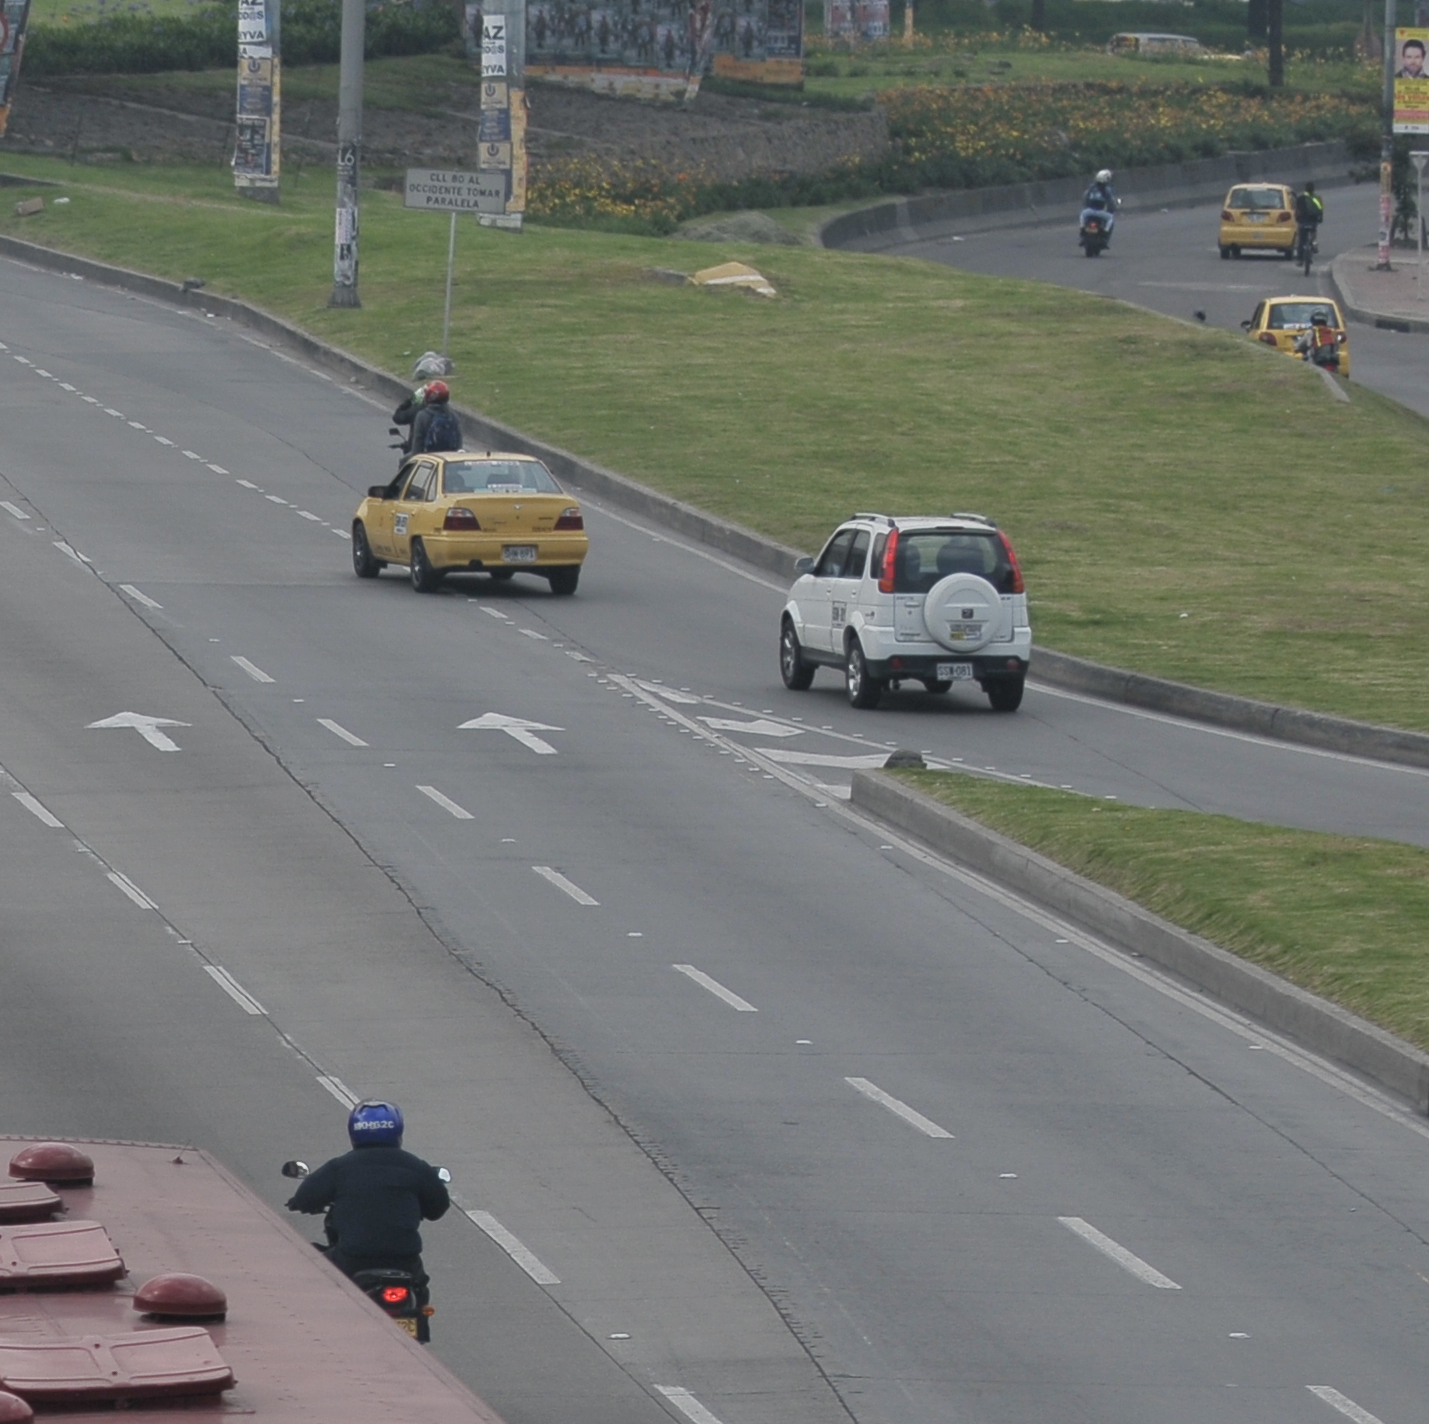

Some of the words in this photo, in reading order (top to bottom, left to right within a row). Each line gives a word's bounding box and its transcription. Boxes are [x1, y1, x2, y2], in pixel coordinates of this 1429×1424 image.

[430, 173, 447, 183] CLL
[468, 175, 481, 185] AL
[409, 183, 463, 196] OCCIDENTE
[466, 188, 501, 198] TOMAR
[426, 196, 479, 208] PARALELA
